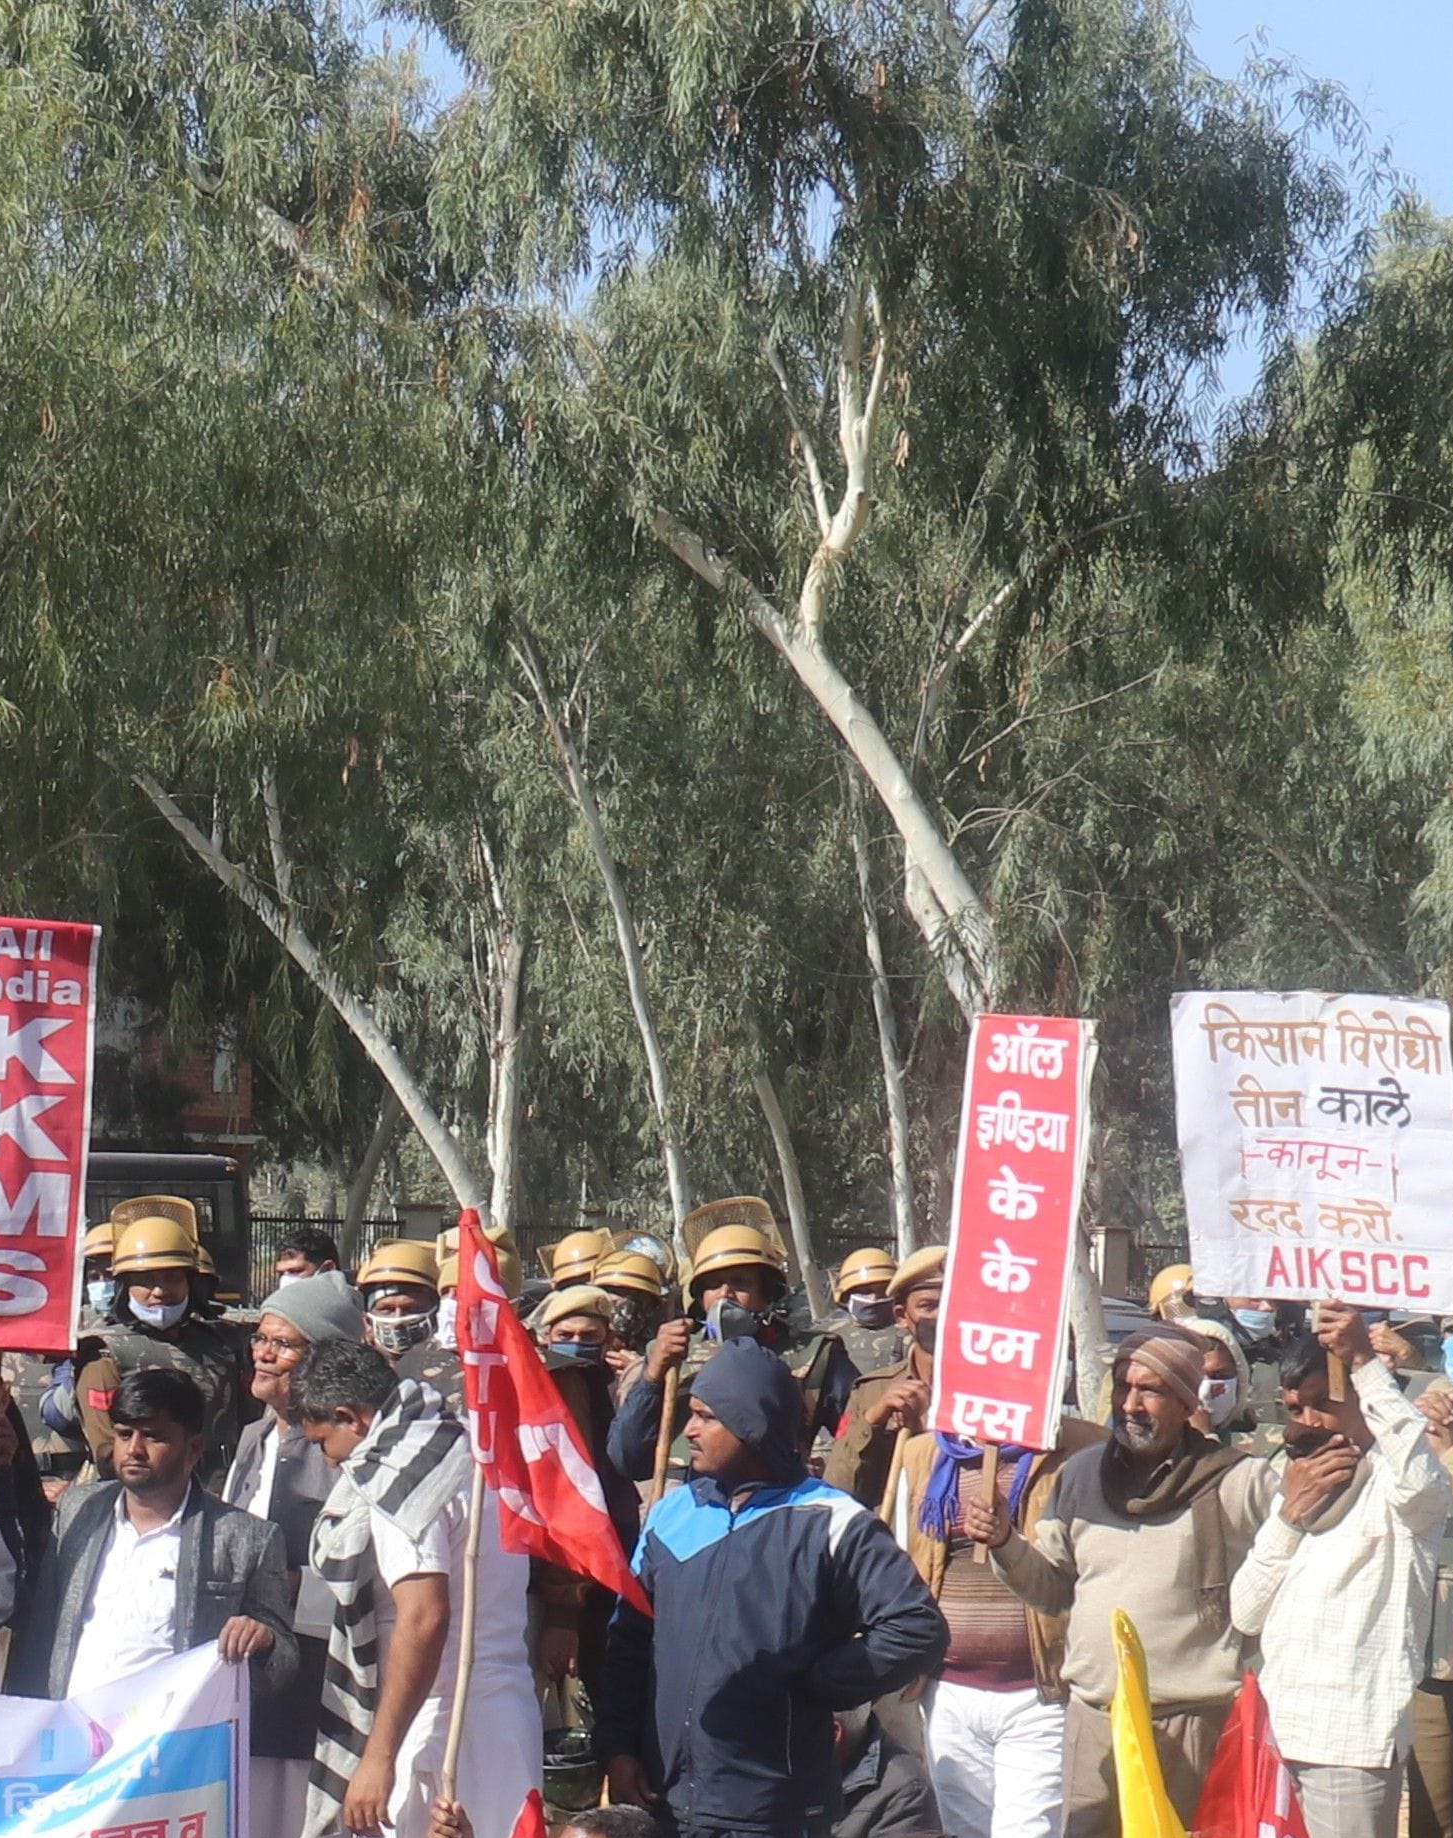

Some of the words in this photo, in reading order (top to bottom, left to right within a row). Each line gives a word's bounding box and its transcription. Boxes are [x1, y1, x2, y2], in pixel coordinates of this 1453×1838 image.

[985, 1023, 1068, 1081] ऑल
[1199, 1003, 1325, 1066] किसान
[976, 1089, 1068, 1153] इण्डिया
[1228, 1074, 1304, 1129] तीन
[1316, 1077, 1414, 1131] काले
[987, 1166, 1044, 1222] के
[980, 1239, 1038, 1294] के
[1266, 1245, 1430, 1298] AIKSCC
[959, 1321, 1041, 1370] एम
[951, 1394, 1033, 1444] एस
